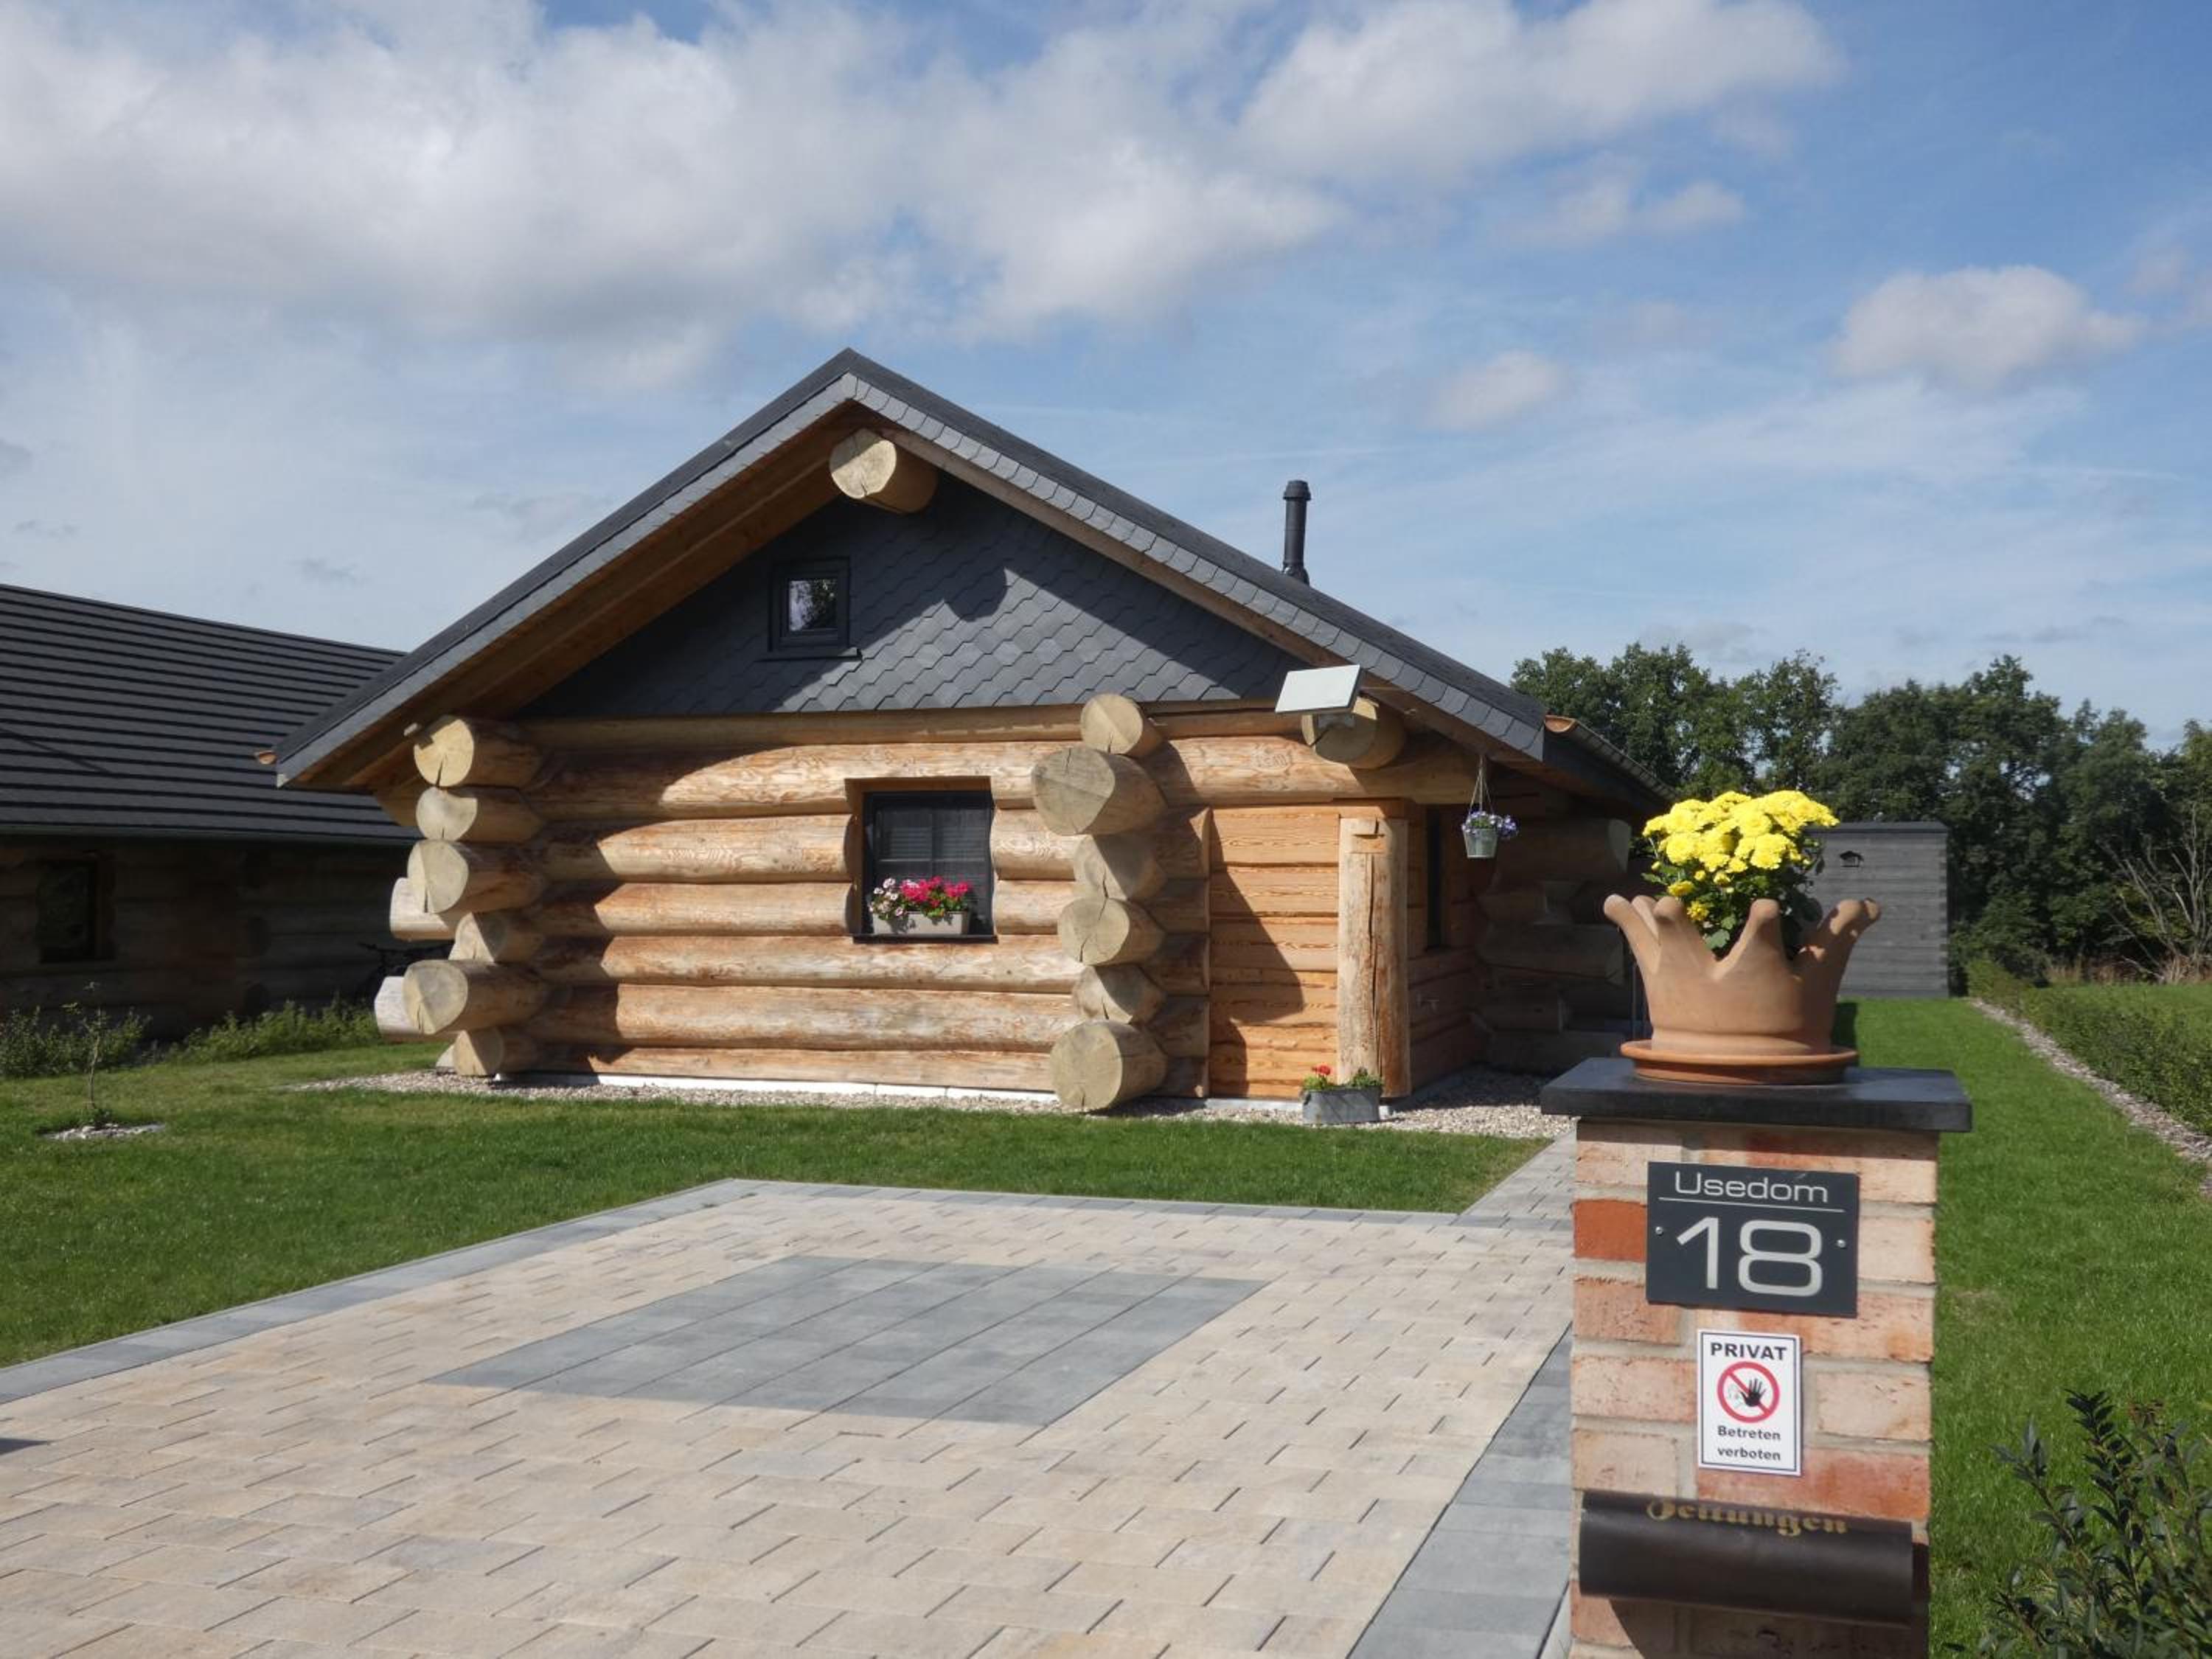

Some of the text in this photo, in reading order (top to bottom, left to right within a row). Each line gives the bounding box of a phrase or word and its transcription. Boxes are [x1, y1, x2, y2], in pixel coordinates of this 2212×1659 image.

[1674, 1171, 1828, 1203] Usedom
[1676, 1217, 1823, 1296] 18
[1710, 1342, 1787, 1360] PRIVAT
[1717, 1425, 1781, 1441] Betreten
[1717, 1447, 1781, 1461] verboten
